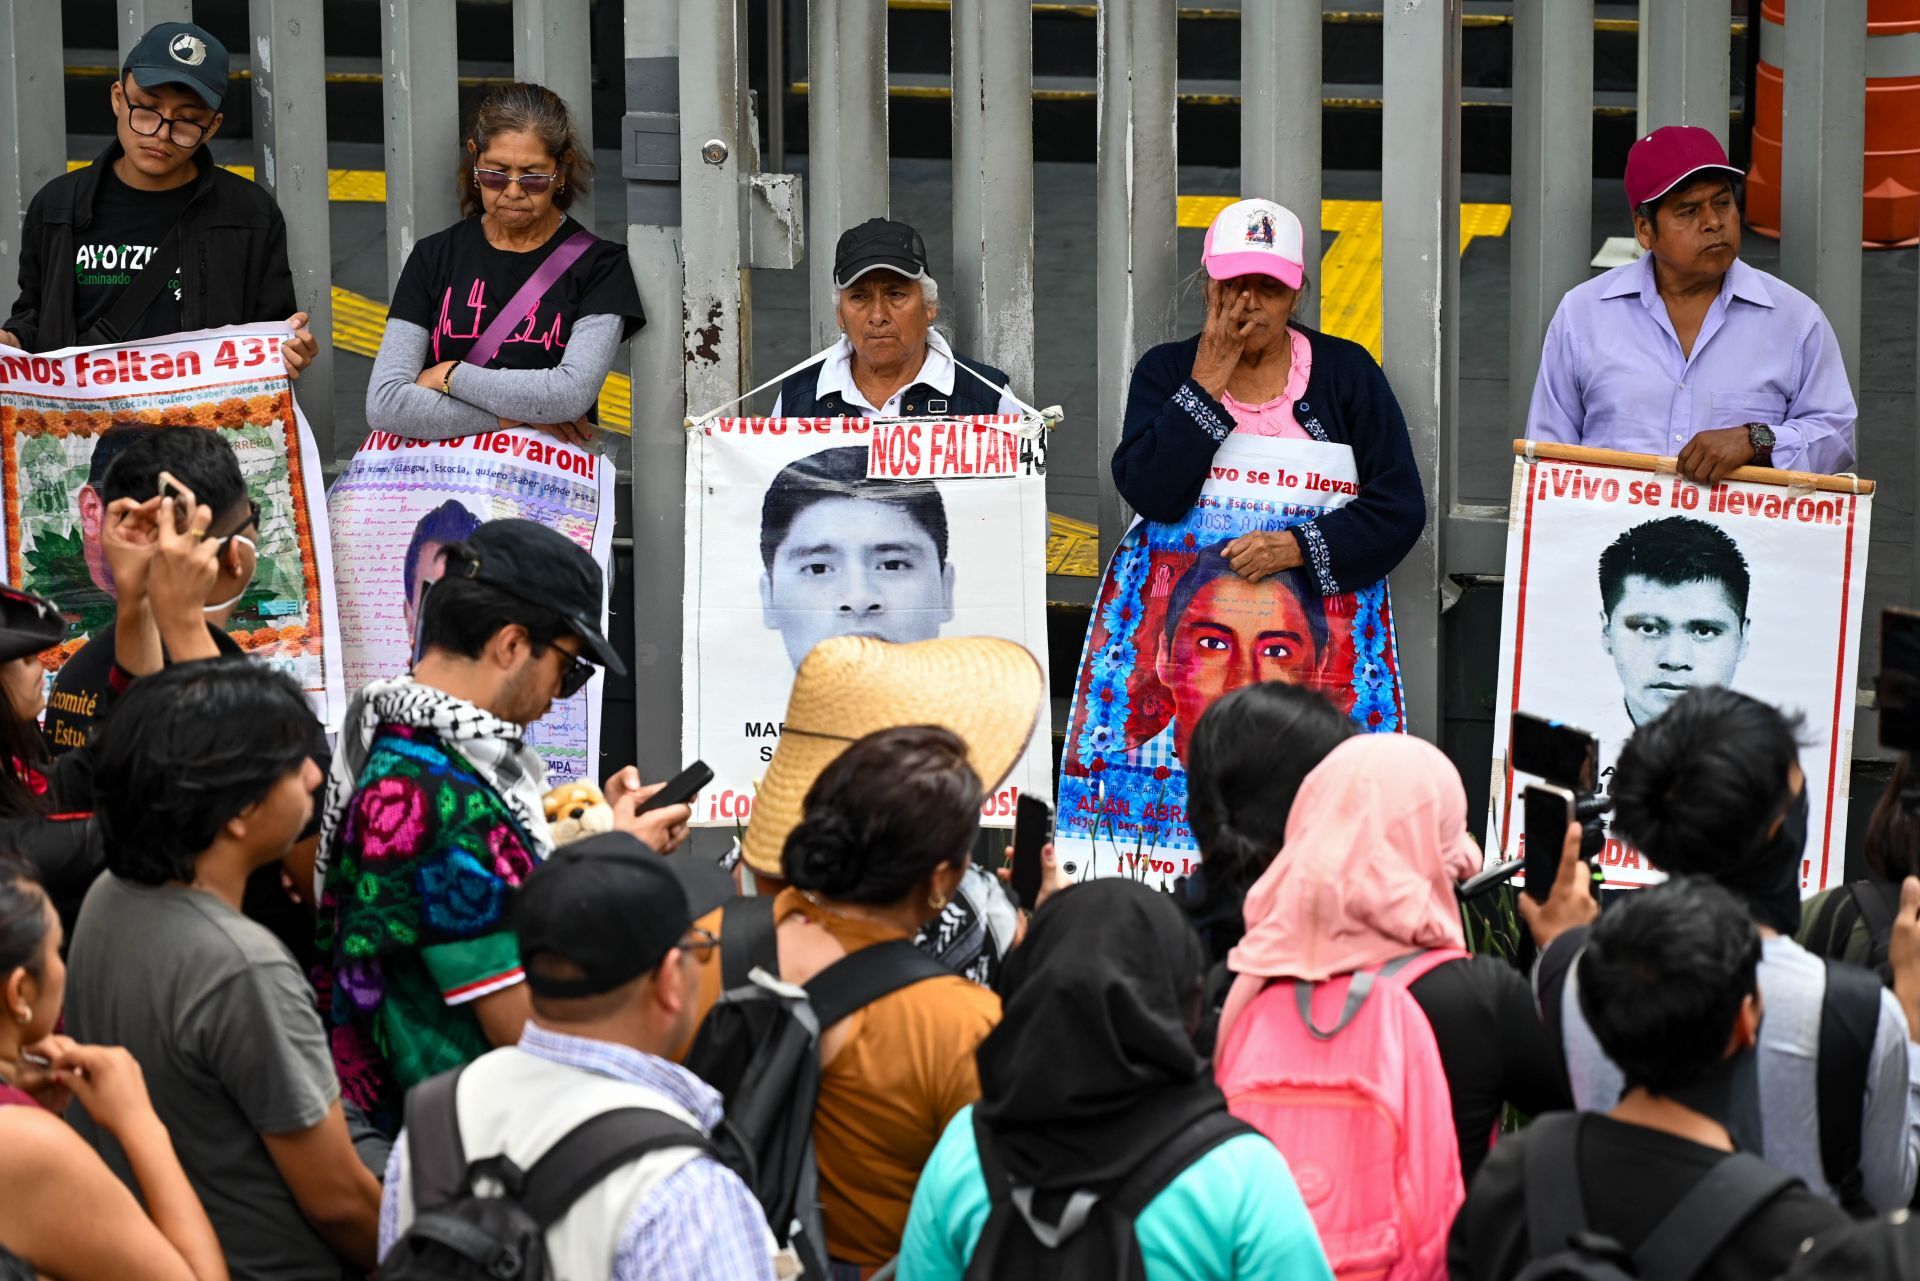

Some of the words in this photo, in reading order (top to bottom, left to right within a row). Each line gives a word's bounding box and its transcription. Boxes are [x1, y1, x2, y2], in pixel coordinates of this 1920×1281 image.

[77, 272, 131, 285] Caminando
[75, 350, 201, 388] faltan
[214, 337, 280, 370] 43!
[158, 394, 193, 405] quiero
[196, 388, 224, 399] saber
[473, 431, 595, 480] llevaron!
[871, 425, 922, 476] NOS
[929, 423, 1018, 475] FALTAN
[394, 464, 429, 474] Glasgow,
[434, 464, 470, 476] Escocia,
[475, 468, 508, 481] quiero
[513, 475, 540, 488] saber
[1246, 470, 1271, 486] se
[1276, 469, 1299, 488] lo
[1229, 500, 1275, 514] Escocia,
[1283, 505, 1316, 517] quiero
[1538, 468, 1620, 503] ¡Vivo
[1628, 480, 1662, 507] se
[1670, 478, 1700, 511] lo
[1708, 484, 1845, 527] llevaron!
[52, 688, 98, 717] comité
[1165, 828, 1172, 837] y
